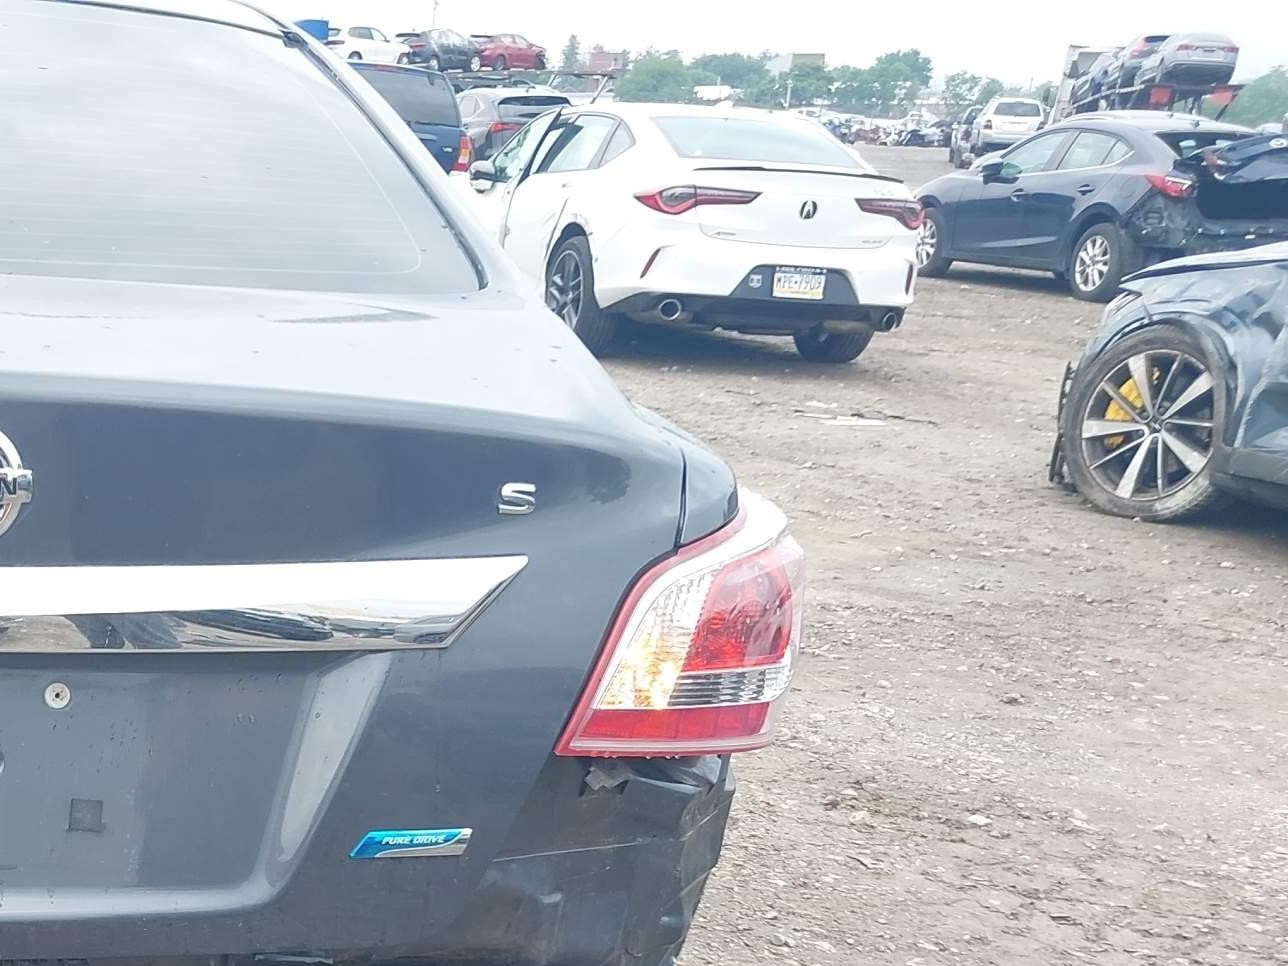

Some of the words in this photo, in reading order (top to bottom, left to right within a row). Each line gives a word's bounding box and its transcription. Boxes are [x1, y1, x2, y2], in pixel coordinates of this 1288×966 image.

[498, 482, 536, 515] S
[381, 835, 412, 845] PURE
[412, 835, 445, 844] DRIVE
